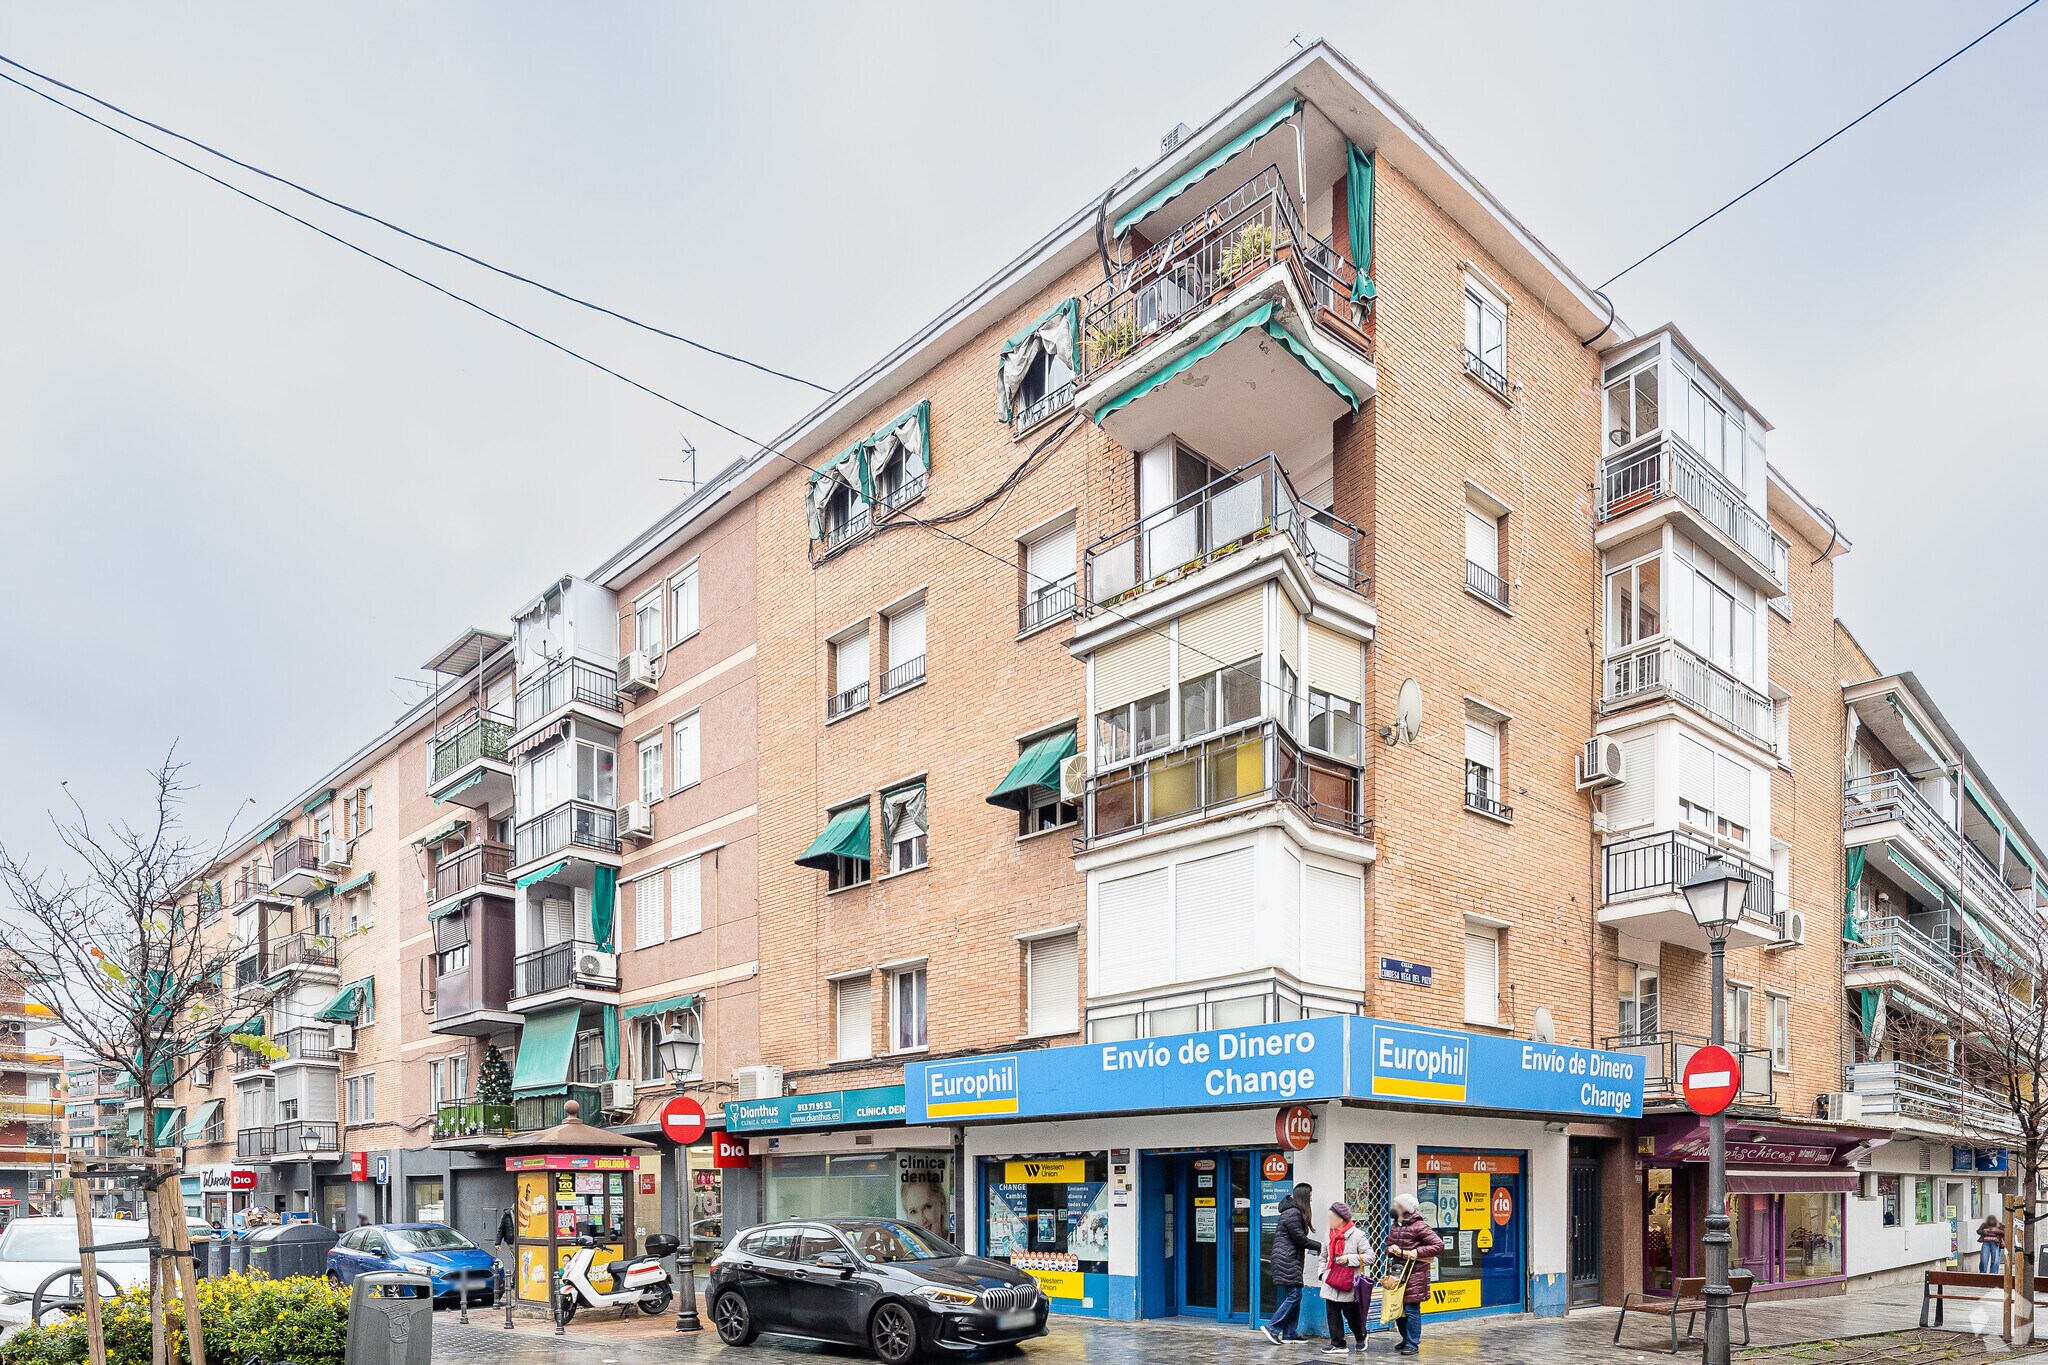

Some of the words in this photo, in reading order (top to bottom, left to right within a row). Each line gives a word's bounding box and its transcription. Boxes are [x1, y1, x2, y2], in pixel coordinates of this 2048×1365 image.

[1382, 969, 1400, 979] CONDESA
[1401, 972, 1411, 981] VEGA
[1412, 974, 1420, 983] DEL
[1102, 1041, 1171, 1071] Envío
[1178, 1038, 1210, 1065] de
[1218, 1031, 1315, 1061] Dinero
[1379, 1037, 1464, 1080] Europhil
[1521, 1045, 1565, 1073] Envío
[1568, 1051, 1586, 1075] de
[1589, 1053, 1633, 1080] Dinero
[931, 1066, 1012, 1099] Europhil
[1205, 1067, 1315, 1098] Change
[1580, 1082, 1631, 1114] Change
[740, 1104, 779, 1119] Dianthus
[797, 1104, 808, 1112] 913
[816, 1102, 823, 1110] 95
[824, 1101, 832, 1109] 33
[856, 1104, 887, 1117] CLÍNICA
[888, 1104, 906, 1115] DEN
[791, 1112, 840, 1124] www.dianthus.es
[1291, 1110, 1310, 1133] ria
[720, 1144, 744, 1157] Dia
[900, 1156, 945, 1169] clínica
[1266, 1158, 1285, 1172] ria
[1426, 1155, 1440, 1171] ria
[1473, 1156, 1486, 1171] ria
[234, 1176, 251, 1184] Dia
[900, 1170, 944, 1183] dental
[1494, 1192, 1510, 1211] ria
